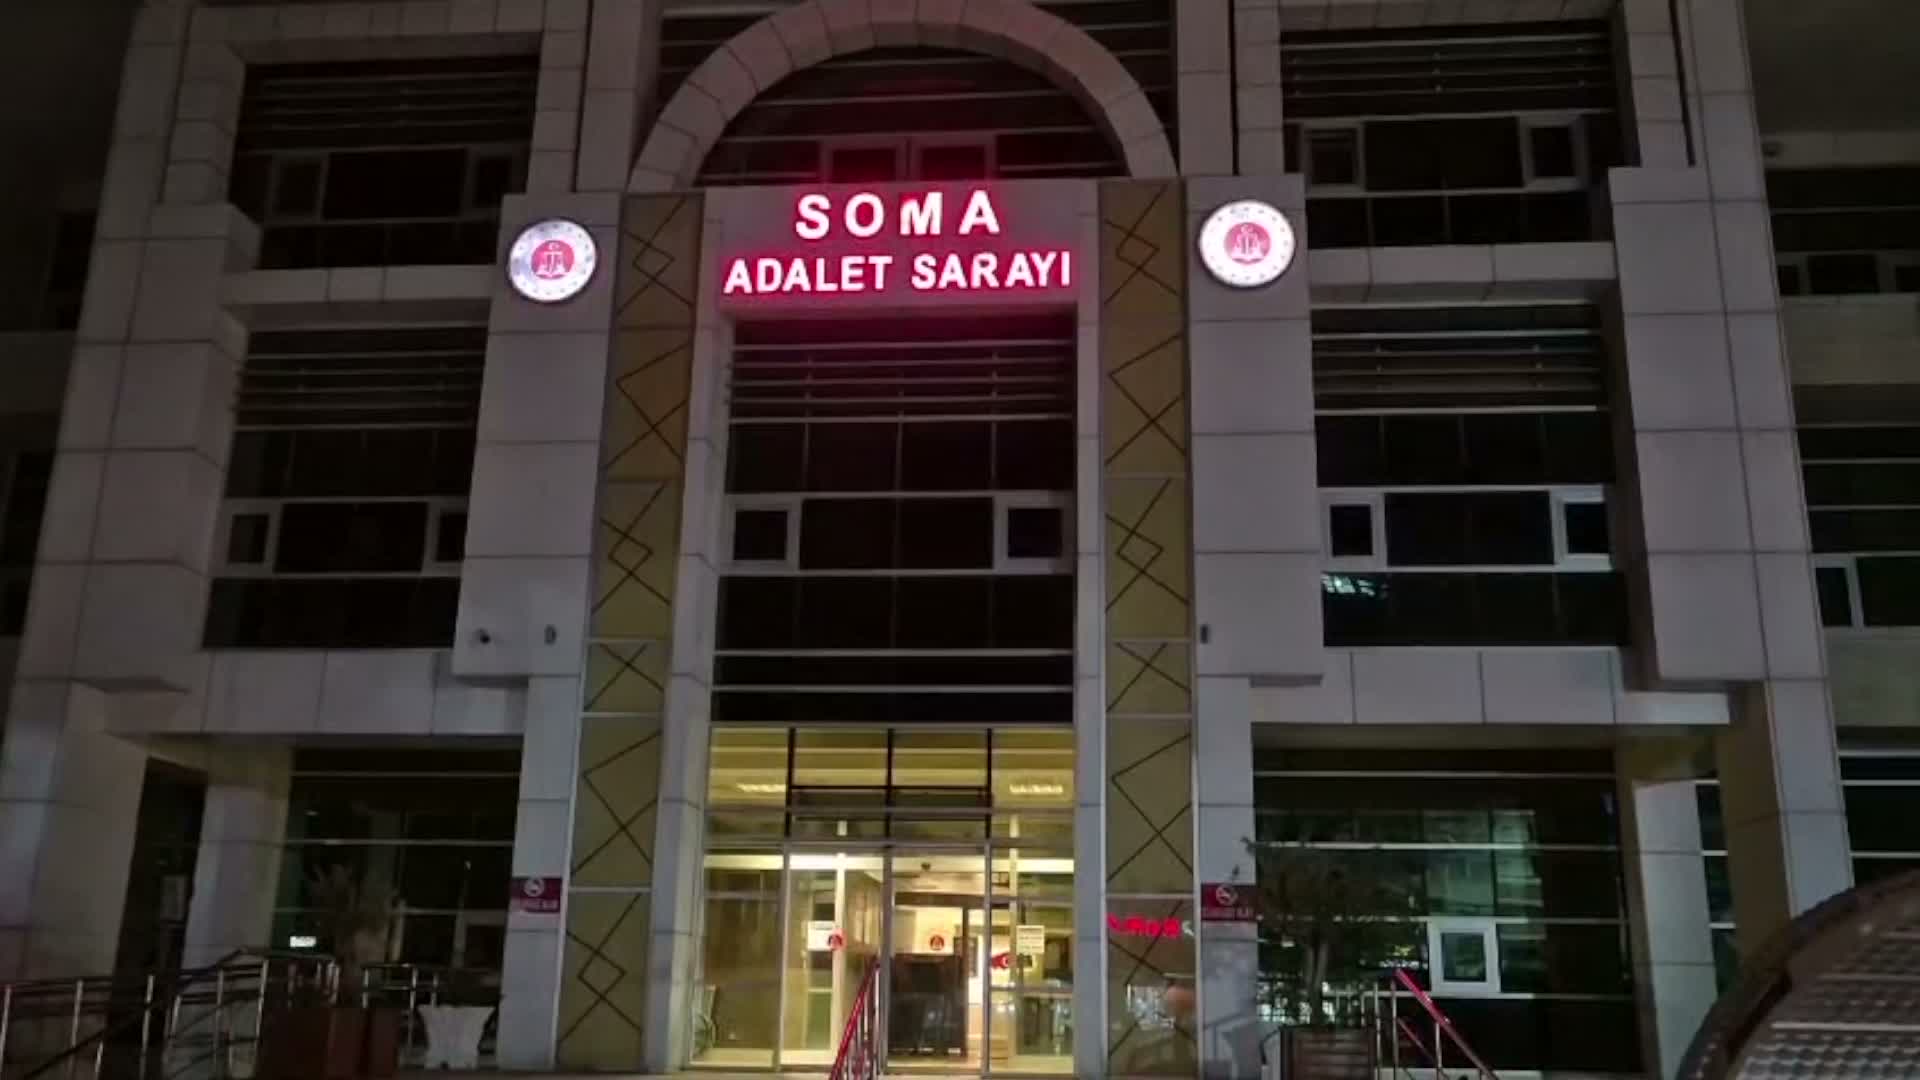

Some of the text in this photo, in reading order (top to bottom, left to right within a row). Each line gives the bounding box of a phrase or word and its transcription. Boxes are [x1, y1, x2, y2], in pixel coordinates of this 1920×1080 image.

[796, 190, 999, 239] SOMA
[724, 251, 1071, 293] ADALET SARAYI
